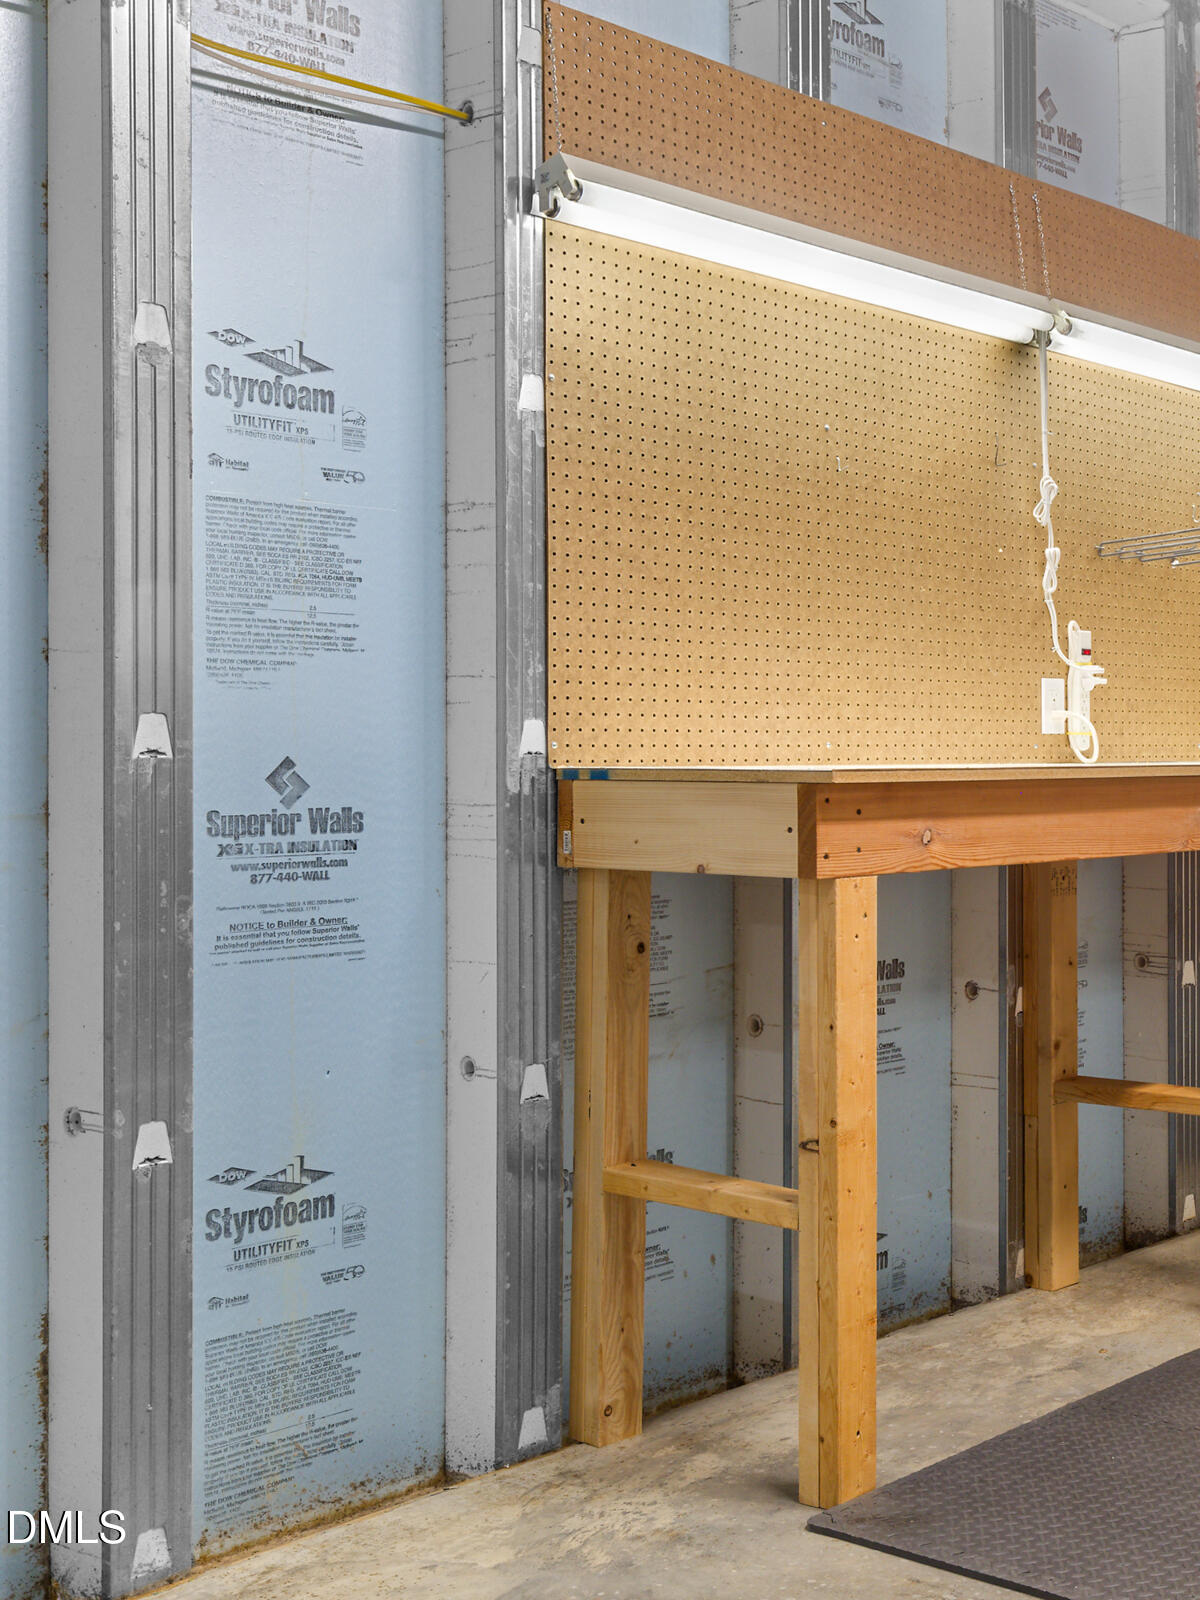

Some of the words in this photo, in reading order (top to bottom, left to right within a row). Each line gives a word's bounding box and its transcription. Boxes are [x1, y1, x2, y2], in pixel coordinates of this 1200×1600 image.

[217, 332, 247, 346] DOW
[205, 364, 336, 414] Styrofoam
[233, 413, 295, 434] UTILITYFIT
[206, 809, 302, 841] Superior
[308, 806, 365, 836] Walls
[244, 842, 284, 856] X-TRA
[286, 839, 359, 854] INSULATION
[230, 857, 349, 872] www.superiorwalls.com
[249, 870, 331, 885] 877-440-WALL
[229, 921, 265, 932] NOTICE
[266, 922, 276, 930] to
[276, 918, 308, 930] Builder
[309, 917, 316, 926] &
[311, 922, 341, 935] Superior
[296, 934, 338, 944] construction
[218, 1171, 248, 1184] DOW
[205, 1193, 336, 1245] Styrofoam
[233, 1239, 295, 1263] UTILITYFIT
